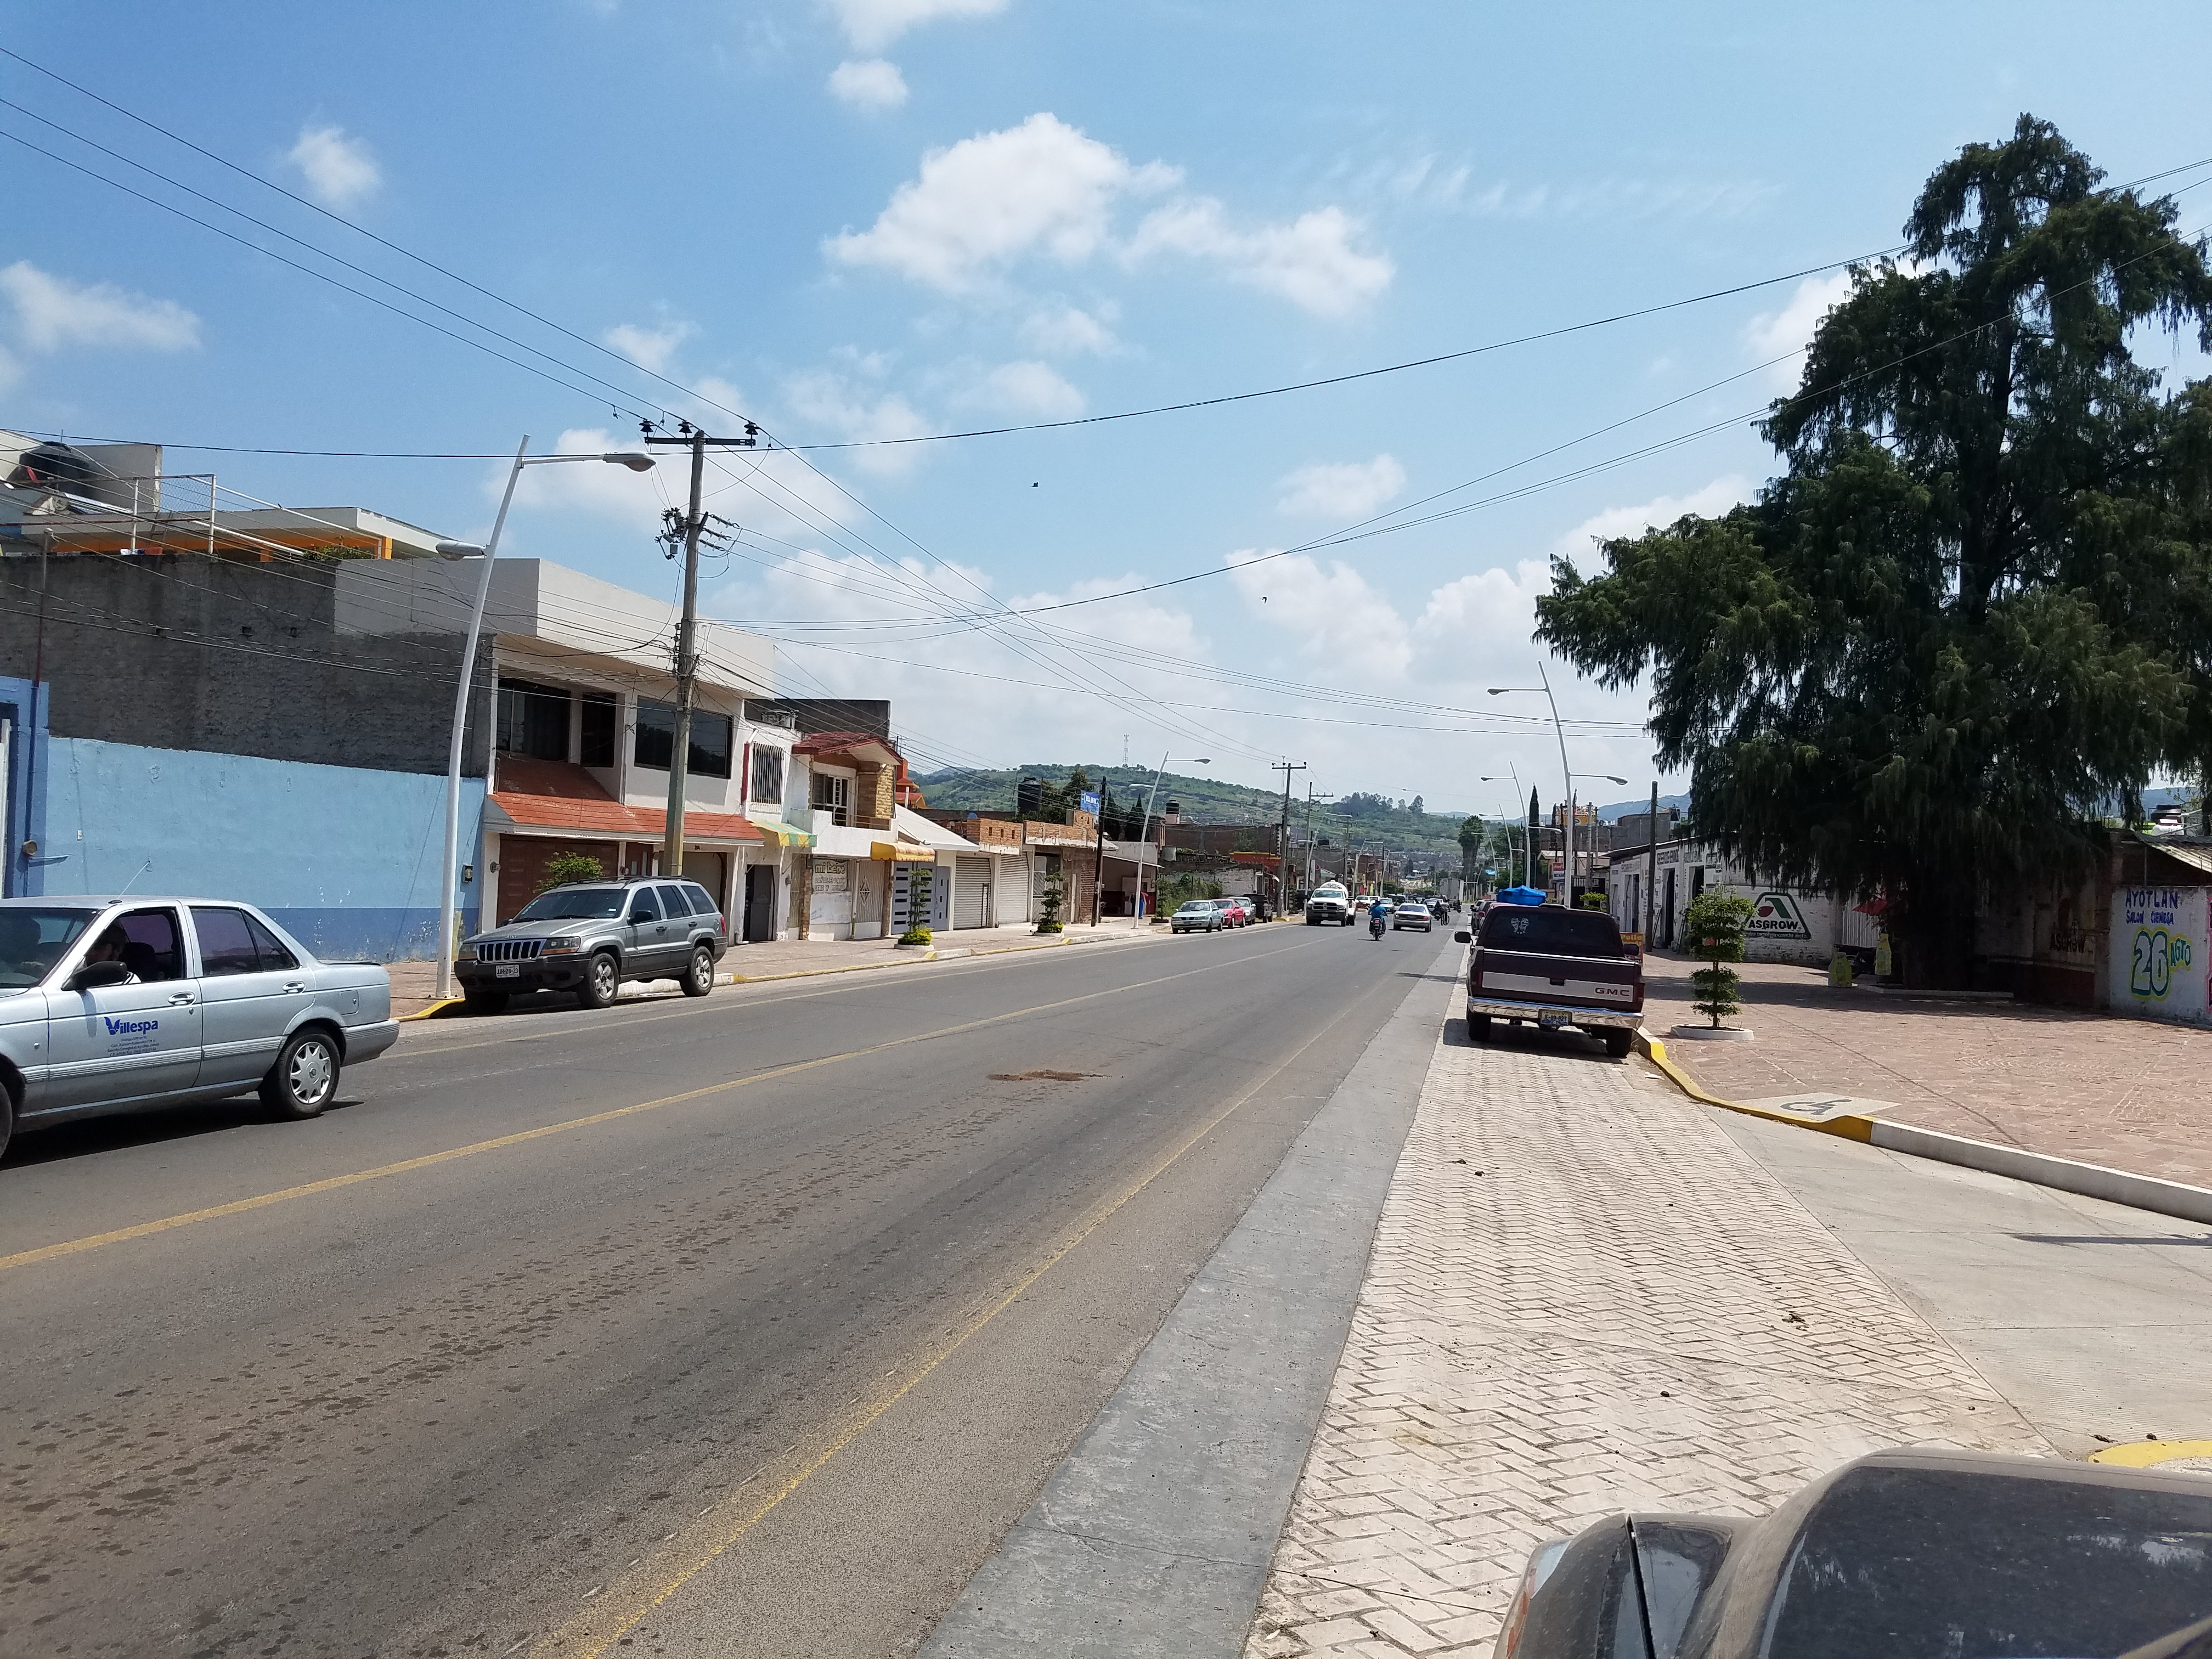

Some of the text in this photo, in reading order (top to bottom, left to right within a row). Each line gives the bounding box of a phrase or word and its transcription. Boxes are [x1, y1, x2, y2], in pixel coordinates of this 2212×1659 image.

[815, 862, 825, 873] mi
[2125, 889, 2178, 909] AYOTLAN
[2126, 909, 2145, 924] SALON
[1748, 919, 1799, 930] ASGROW
[2131, 930, 2169, 996] 26
[2170, 938, 2191, 967] AGTO
[1595, 987, 1630, 996] GMC
[104, 1017, 158, 1035] Villespa
